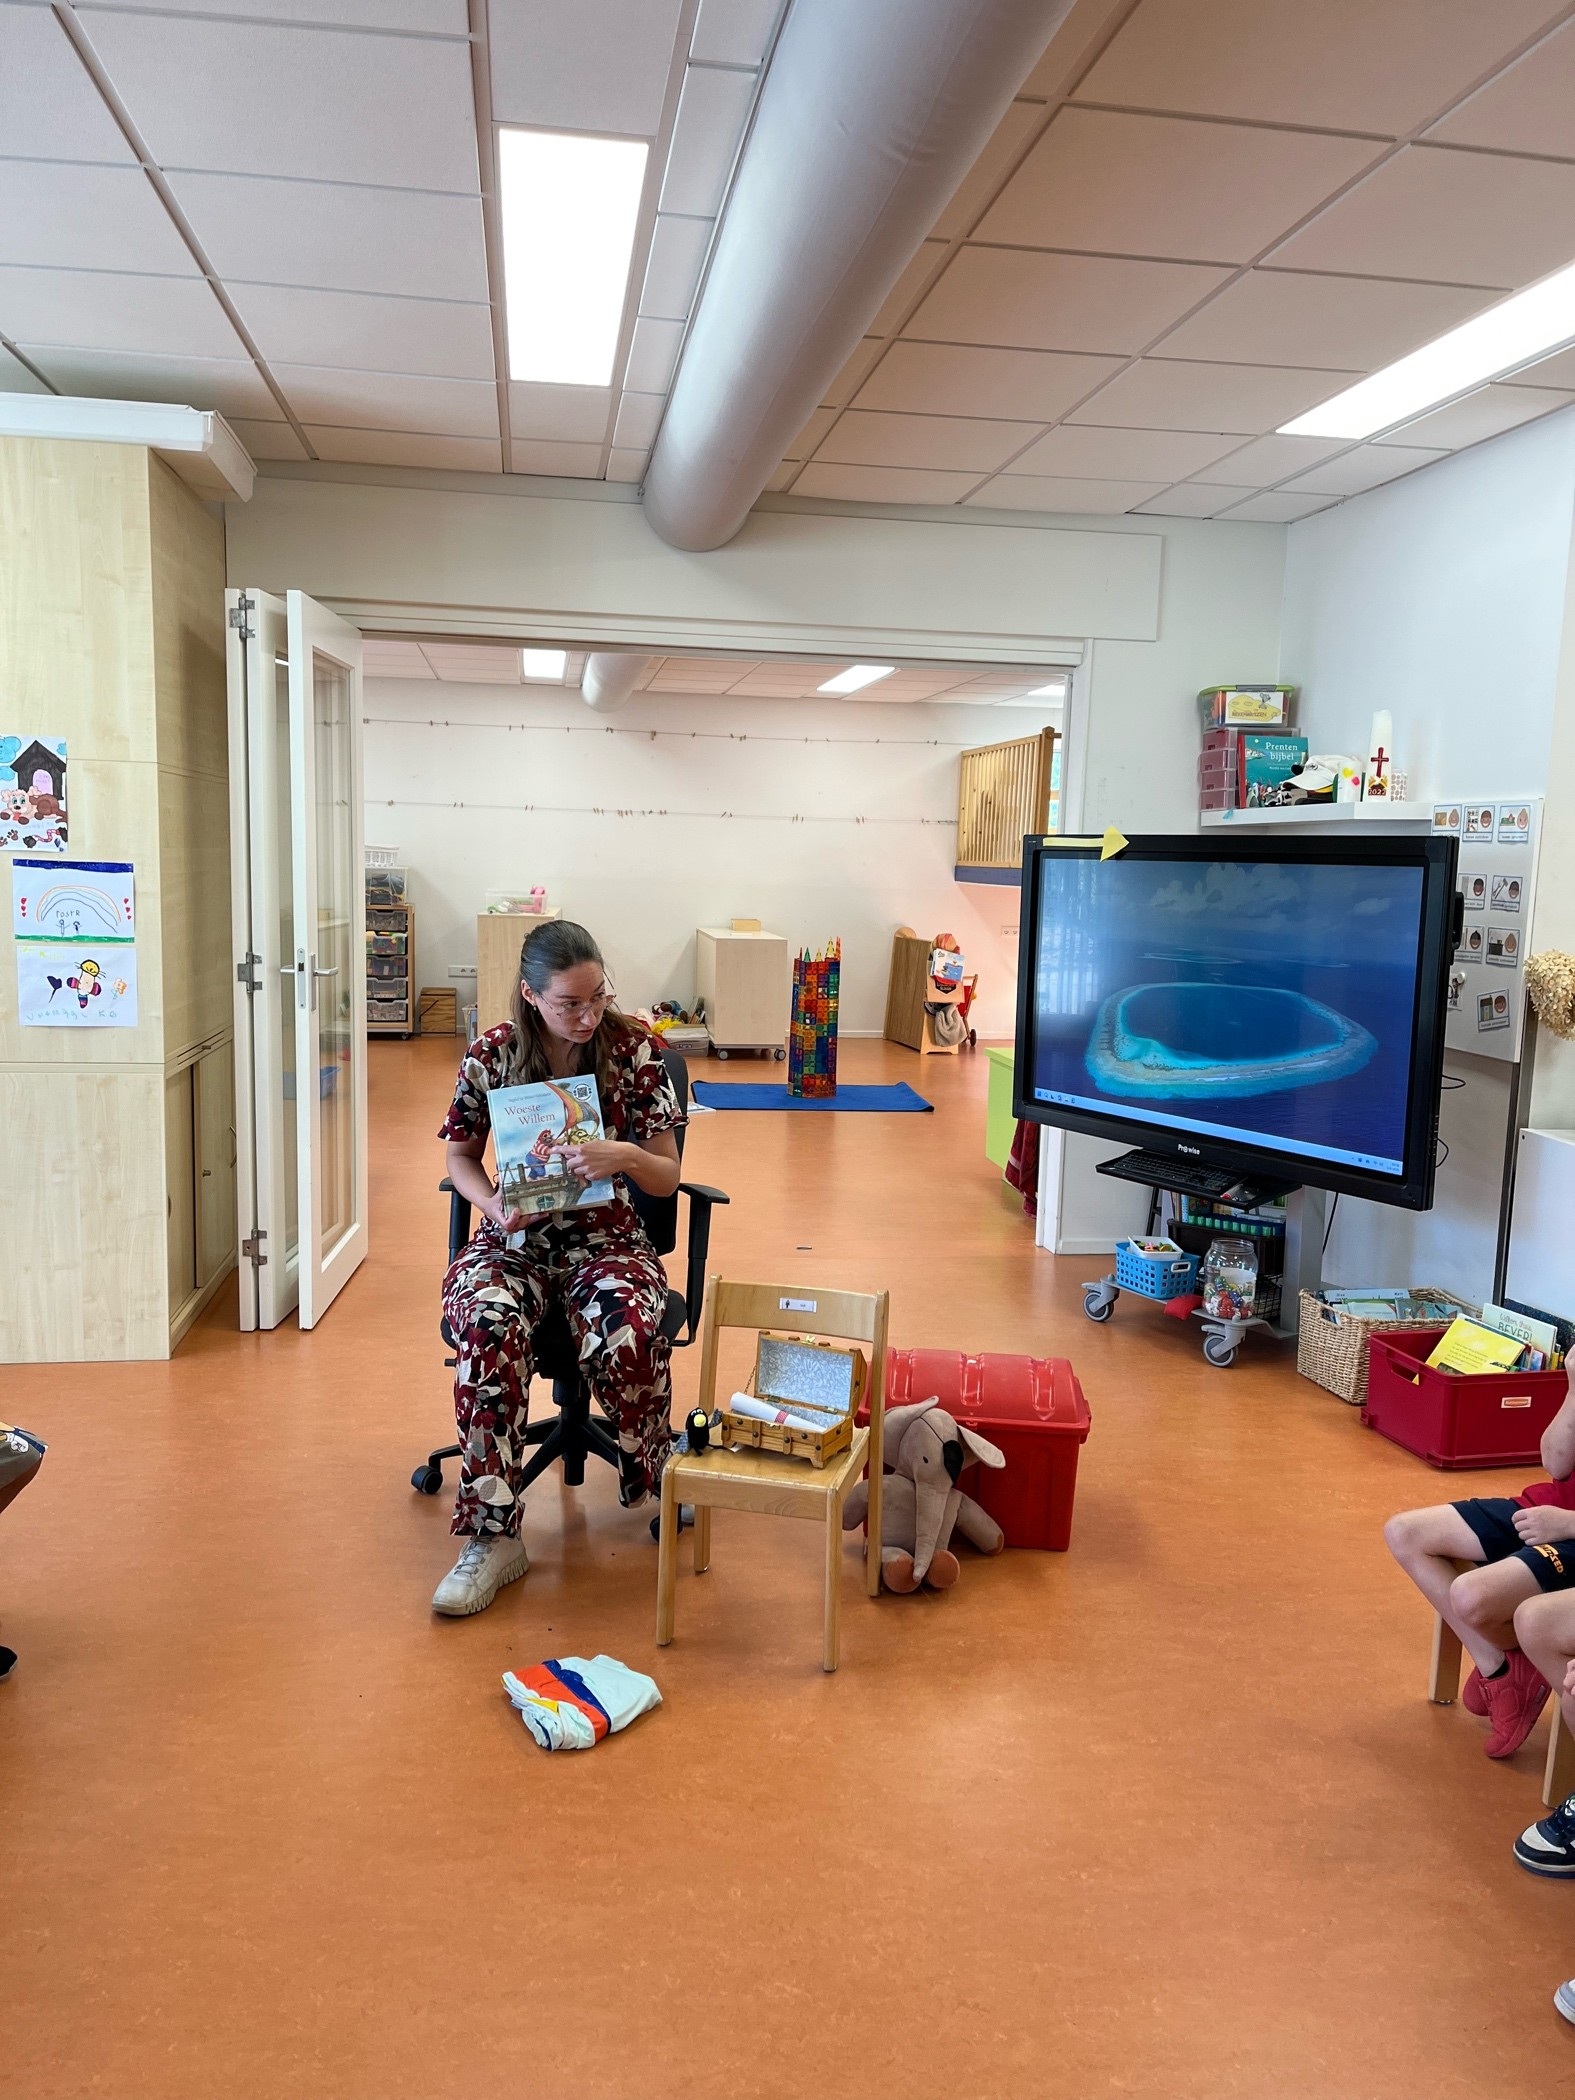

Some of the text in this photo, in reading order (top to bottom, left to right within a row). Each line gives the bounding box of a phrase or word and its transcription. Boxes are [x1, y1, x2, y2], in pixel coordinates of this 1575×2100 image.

[1265, 741, 1298, 751] Prenten
[1270, 752, 1294, 763] bijbel
[1368, 788, 1386, 796] 2022
[504, 1104, 541, 1116] Woeste
[518, 1113, 556, 1126] Willem
[1498, 1321, 1533, 1343] BEVER!
